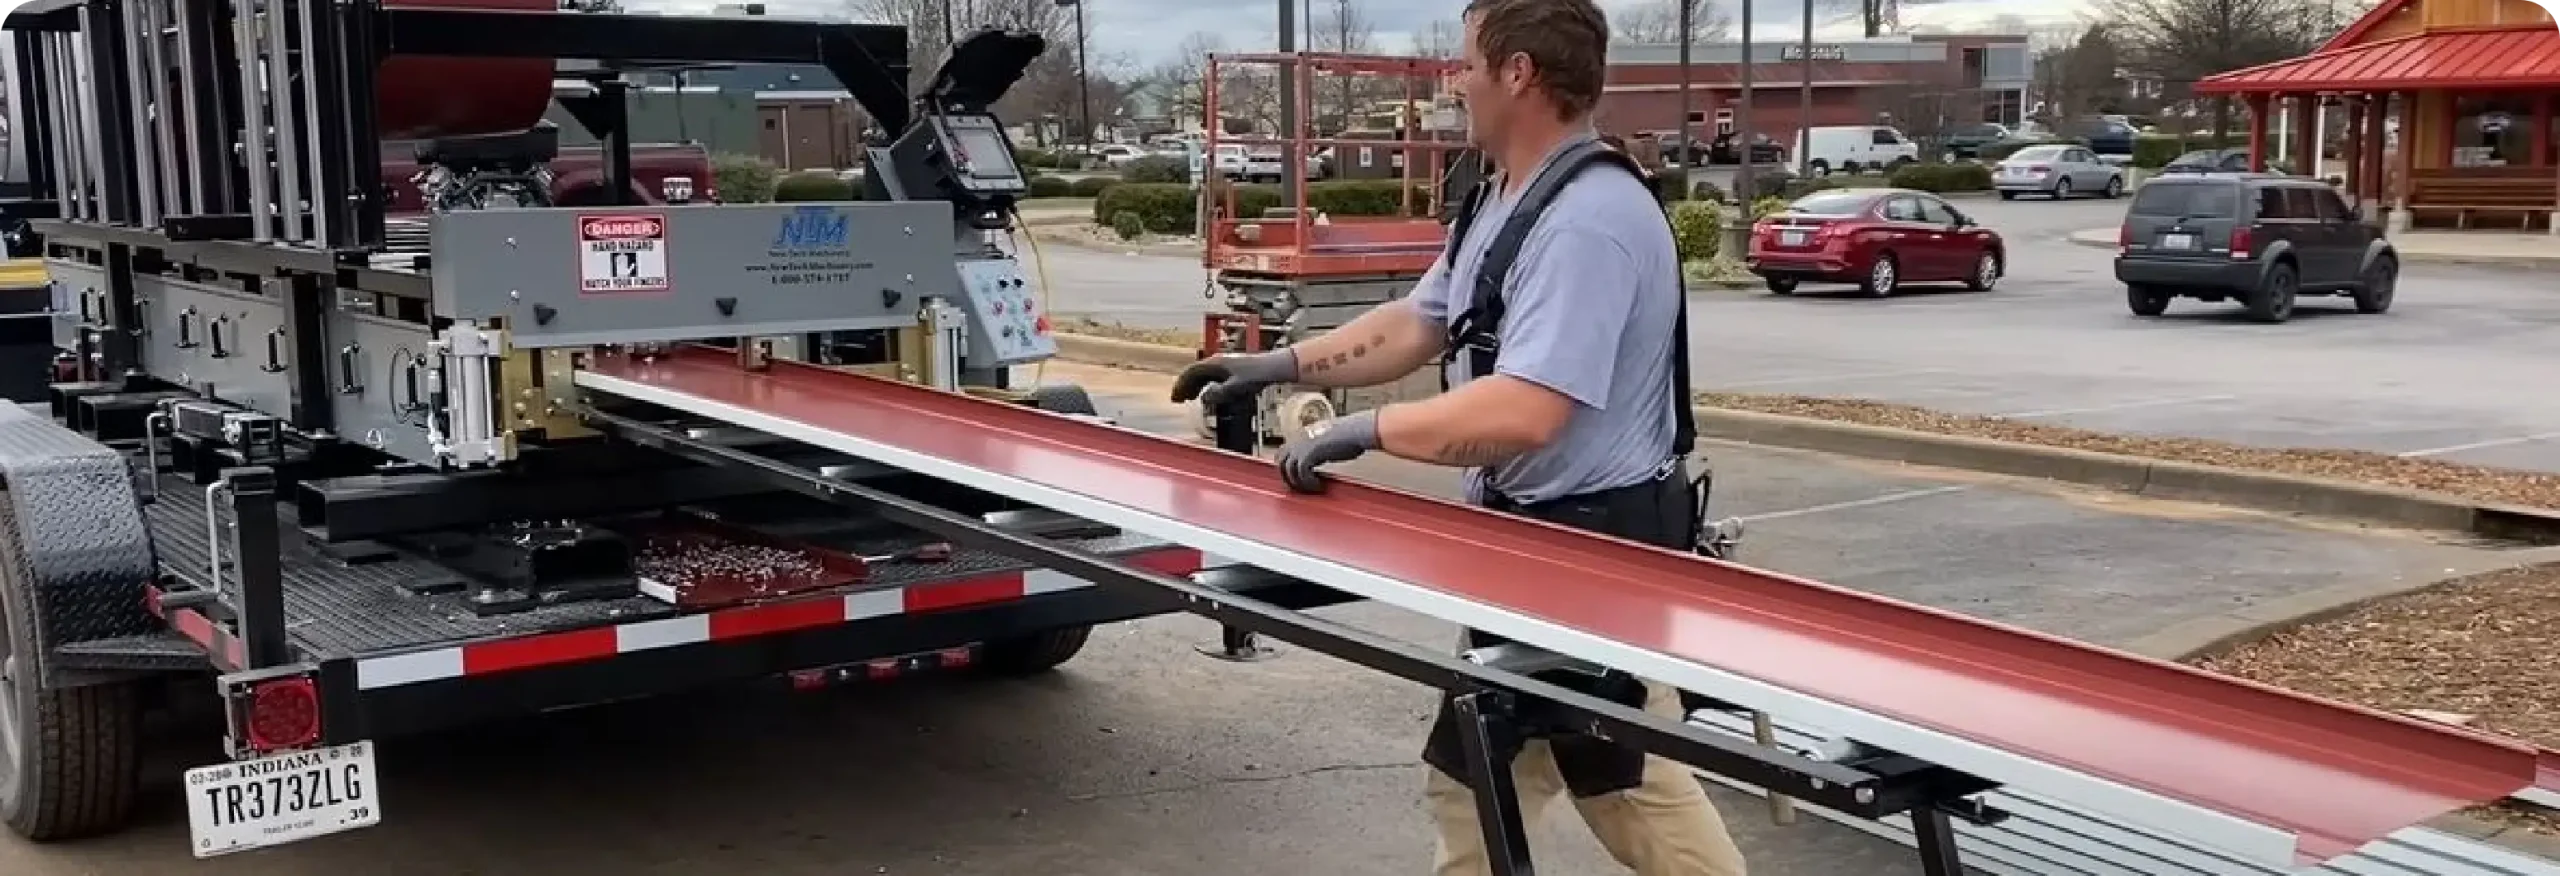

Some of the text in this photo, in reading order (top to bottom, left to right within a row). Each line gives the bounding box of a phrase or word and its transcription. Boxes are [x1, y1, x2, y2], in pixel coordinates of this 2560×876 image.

[592, 222, 653, 236] DANGER
[775, 207, 849, 246] NTM
[239, 752, 323, 778] INDIANA
[206, 763, 361, 827] TR373ZLG
[349, 806, 369, 821] 39
